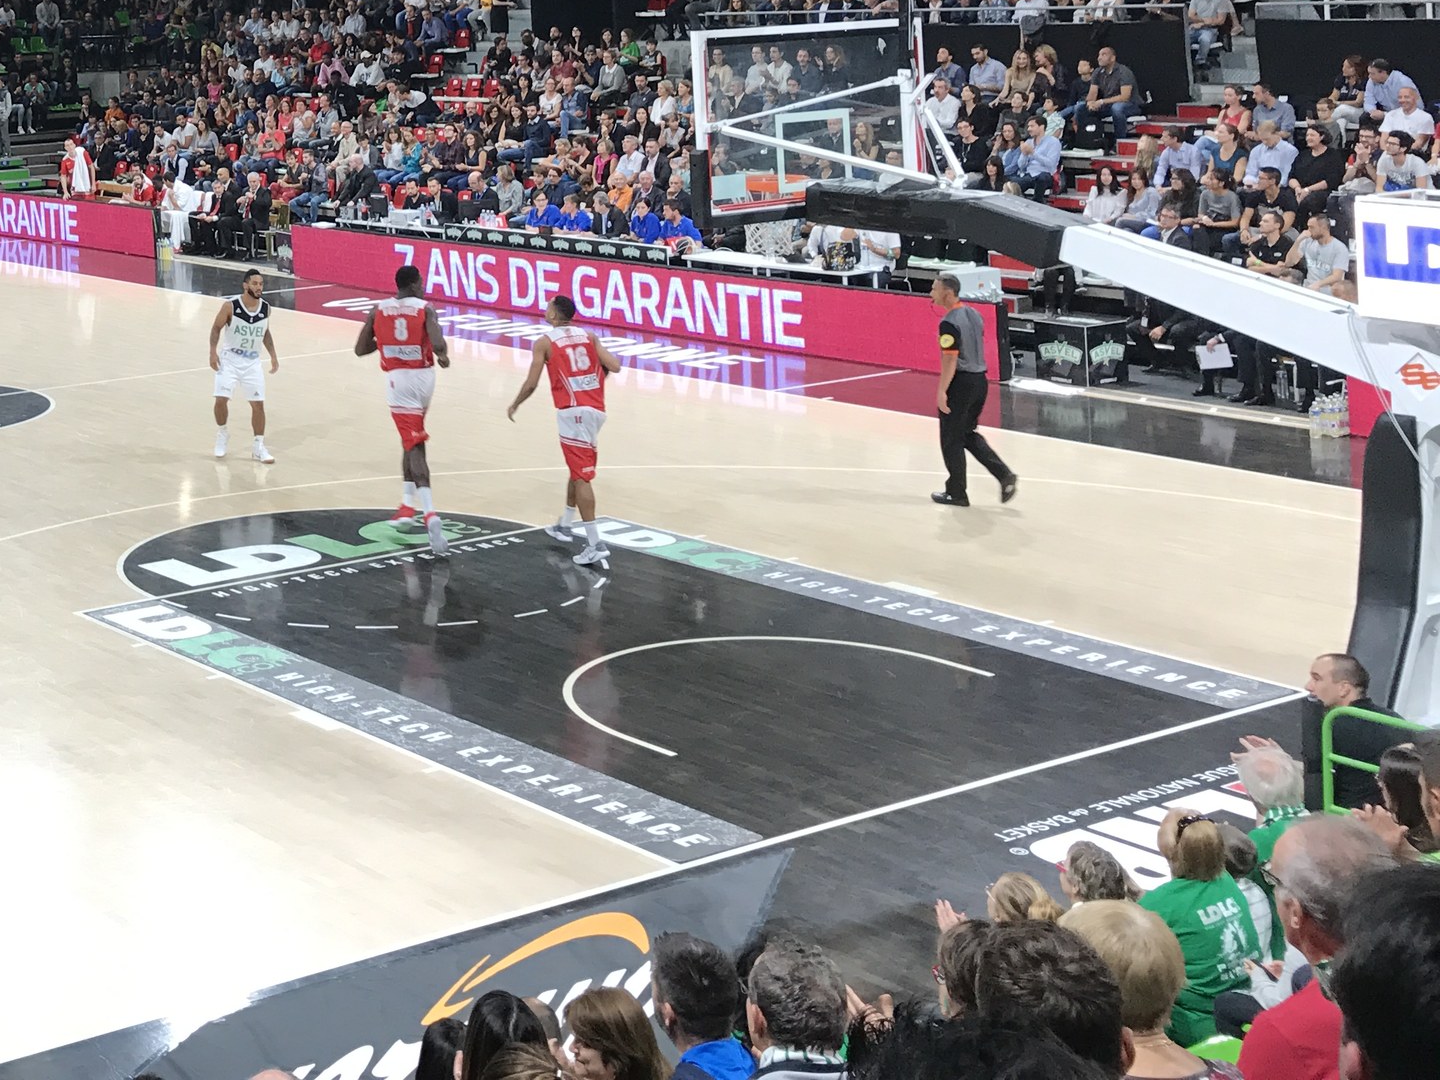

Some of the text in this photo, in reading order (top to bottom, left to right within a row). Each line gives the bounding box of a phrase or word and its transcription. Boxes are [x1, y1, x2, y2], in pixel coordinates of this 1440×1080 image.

[425, 248, 500, 304] ANS
[509, 256, 560, 311] DE
[572, 265, 806, 348] GARANTIE
[234, 325, 265, 338] ASVEL
[240, 338, 255, 348] 21
[394, 318, 408, 342] 8
[231, 348, 260, 360] LDLC
[1044, 340, 1078, 358] ASVEL
[1094, 340, 1122, 358] ASVEL
[212, 565, 360, 599] HIGH-TECH
[102, 605, 288, 668] LDLC
[762, 571, 1248, 700] HIGH-TECH EXPERIENCE
[273, 672, 712, 848] HIGH-TECH EXPERIENCE
[1088, 776, 1202, 814] NATIONALE
[1068, 806, 1089, 818] de
[994, 814, 1076, 843] BASKET
[1197, 897, 1241, 926] LDLC
